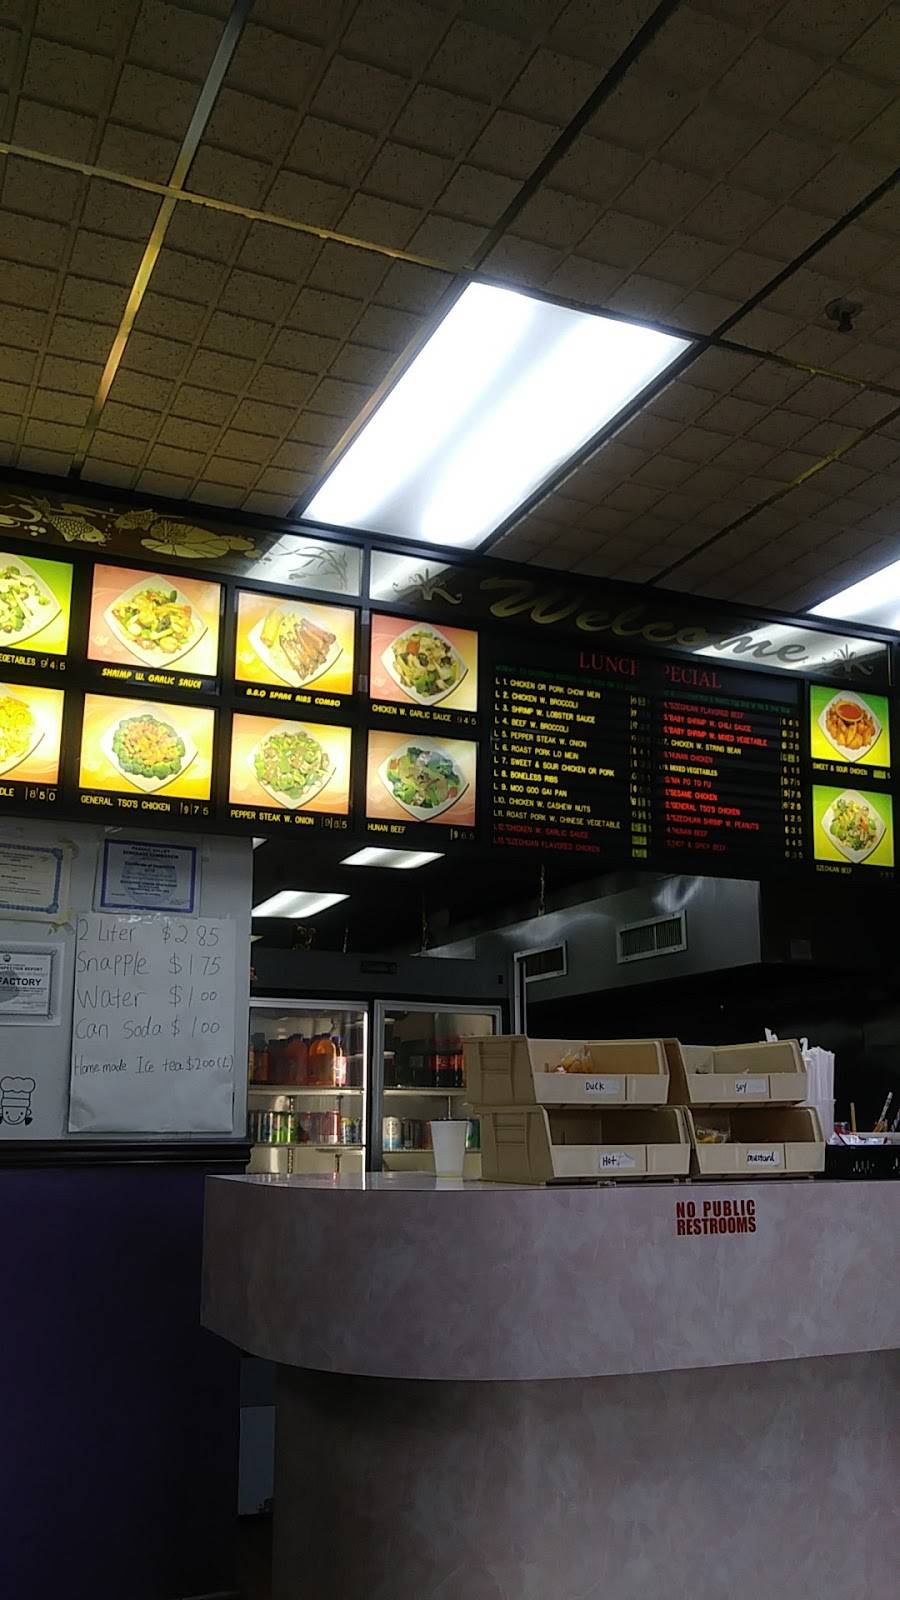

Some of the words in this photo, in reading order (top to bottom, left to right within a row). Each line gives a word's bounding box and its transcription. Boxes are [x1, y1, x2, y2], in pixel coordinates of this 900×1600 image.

[479, 577, 811, 663] Welcome
[101, 668, 132, 681] SHRIMP
[148, 673, 175, 685] GARLIC
[179, 678, 202, 689] SAUCE
[510, 679, 535, 690] CHICKEN
[538, 683, 546, 691] OR
[549, 685, 564, 694] PORK
[567, 687, 584, 696] CHOW
[315, 697, 341, 707] COMBO
[511, 692, 537, 703] CHICKEN
[550, 698, 578, 709] BROCCOLI
[372, 703, 397, 715] CHICKEN
[409, 709, 430, 720] GARLIC
[432, 711, 452, 722] SAUCE
[511, 705, 534, 715] SHRIMP
[546, 710, 574, 720] LOBSTER
[576, 714, 596, 724] SAUCE
[511, 719, 527, 727] BEEF
[540, 722, 569, 733] BROCCOLI
[510, 732, 534, 741] PEPPER
[536, 735, 556, 744] STEAK
[569, 739, 587, 748] ONION
[671, 739, 694, 749] CHICKEN
[705, 743, 725, 754] STRING
[727, 746, 742, 755] BEAN
[511, 745, 531, 754] ROAST
[535, 748, 550, 756] PORK
[553, 750, 562, 758] LO
[564, 751, 579, 760] MEIN
[510, 758, 531, 767] SWEET
[543, 761, 559, 770] SOUR
[561, 763, 586, 774] CHICKEN
[588, 767, 597, 775] OR
[599, 768, 615, 777] PORK
[510, 771, 542, 782] BONELESS
[510, 784, 523, 793] MOO
[526, 786, 539, 795] GOO
[555, 789, 567, 797] PAN
[80, 795, 113, 806] GENERAL
[141, 801, 171, 812] CHICKEN
[509, 797, 534, 808] CHICKEN
[575, 804, 591, 813] NUTS
[231, 809, 257, 820] PEPPER
[259, 812, 281, 822] STEAK
[295, 816, 314, 826] ONION
[507, 810, 527, 820] ROAST
[530, 813, 546, 821] PORK
[587, 819, 621, 829] VEGETABLE
[367, 823, 388, 833] HUNAN
[390, 825, 406, 834] BEEF
[79, 919, 88, 941] 2
[98, 920, 137, 944] Liter
[77, 950, 150, 976] Snapple
[77, 985, 147, 1008] Water
[75, 1017, 109, 1040] Can
[123, 1015, 162, 1039] Soda
[676, 1201, 695, 1218] NO
[703, 1199, 756, 1217] PUBLIC
[677, 1216, 757, 1236] RESTROOMS
